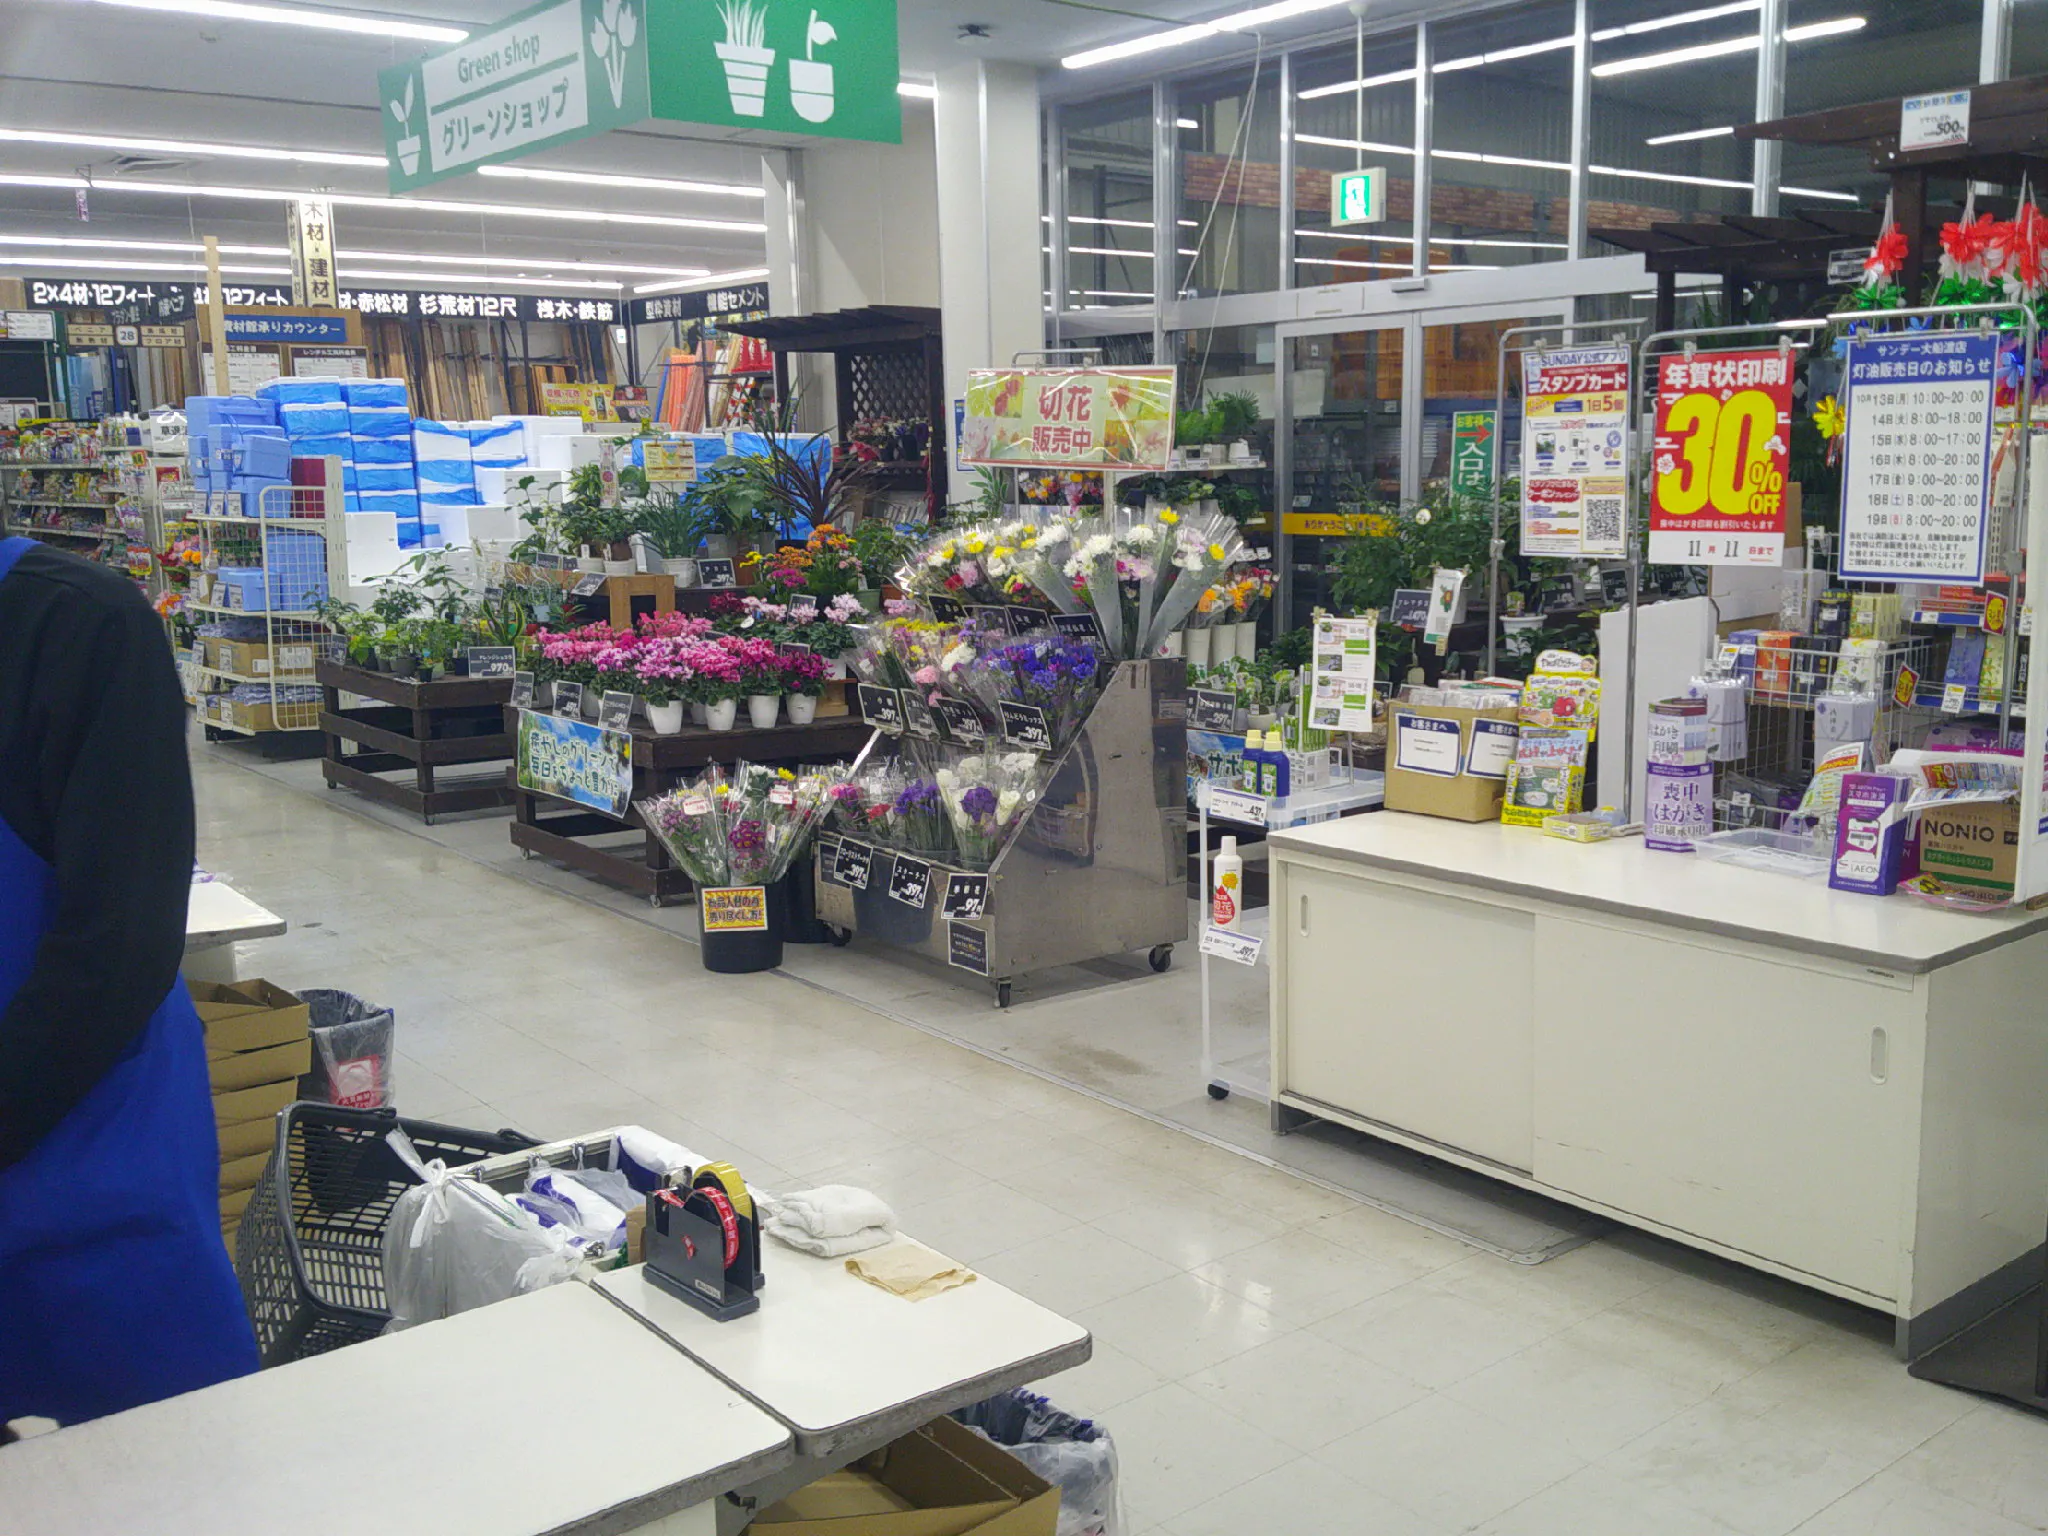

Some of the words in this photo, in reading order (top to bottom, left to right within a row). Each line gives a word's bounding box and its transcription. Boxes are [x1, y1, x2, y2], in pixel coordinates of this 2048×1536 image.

[457, 48, 500, 84] Green
[504, 33, 541, 68] shop
[442, 77, 570, 156] グリーンショップ
[304, 202, 330, 299] 木材・建材
[121, 330, 135, 341] 28
[1877, 340, 1968, 357] サンデー大船渡店
[1664, 357, 1788, 389] 年賀状印刷
[1852, 357, 1992, 379] 灯油販売日のお知らせ
[1540, 372, 1628, 394] スタンプカード
[1038, 384, 1093, 422] 切花
[1031, 425, 1092, 455] 販売中
[1750, 493, 1781, 516] OFF
[1410, 718, 1448, 732] お客さまへ
[1663, 781, 1700, 802] 喪中
[1652, 802, 1706, 824] はがき
[1924, 819, 1995, 842] NONIO
